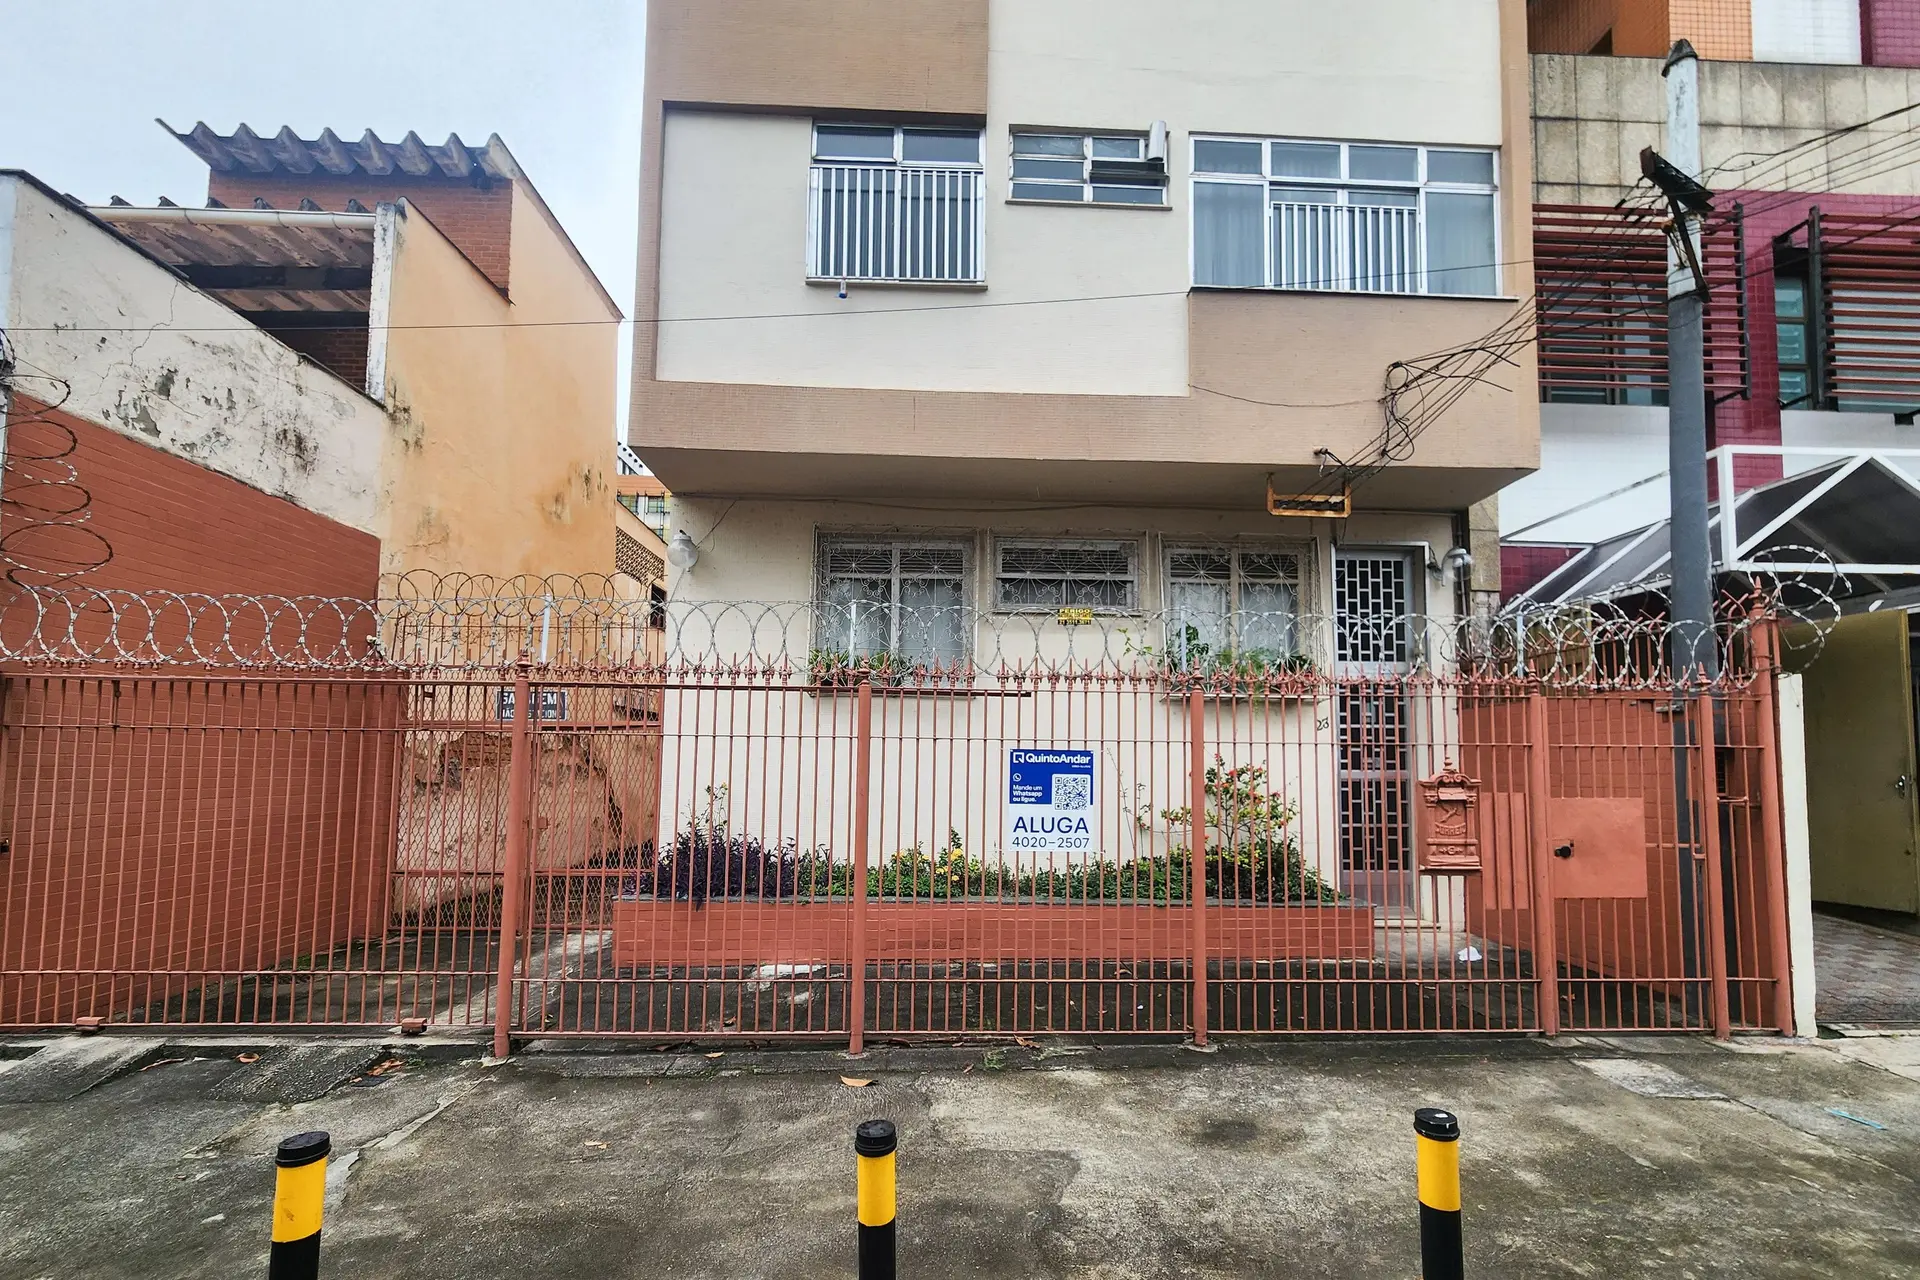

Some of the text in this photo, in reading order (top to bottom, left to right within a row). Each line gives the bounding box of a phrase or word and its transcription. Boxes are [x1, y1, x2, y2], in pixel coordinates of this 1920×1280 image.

[1025, 752, 1091, 764] QuintoAndar
[1013, 816, 1089, 834] ALUGA
[1012, 836, 1090, 848] 4020-2507
